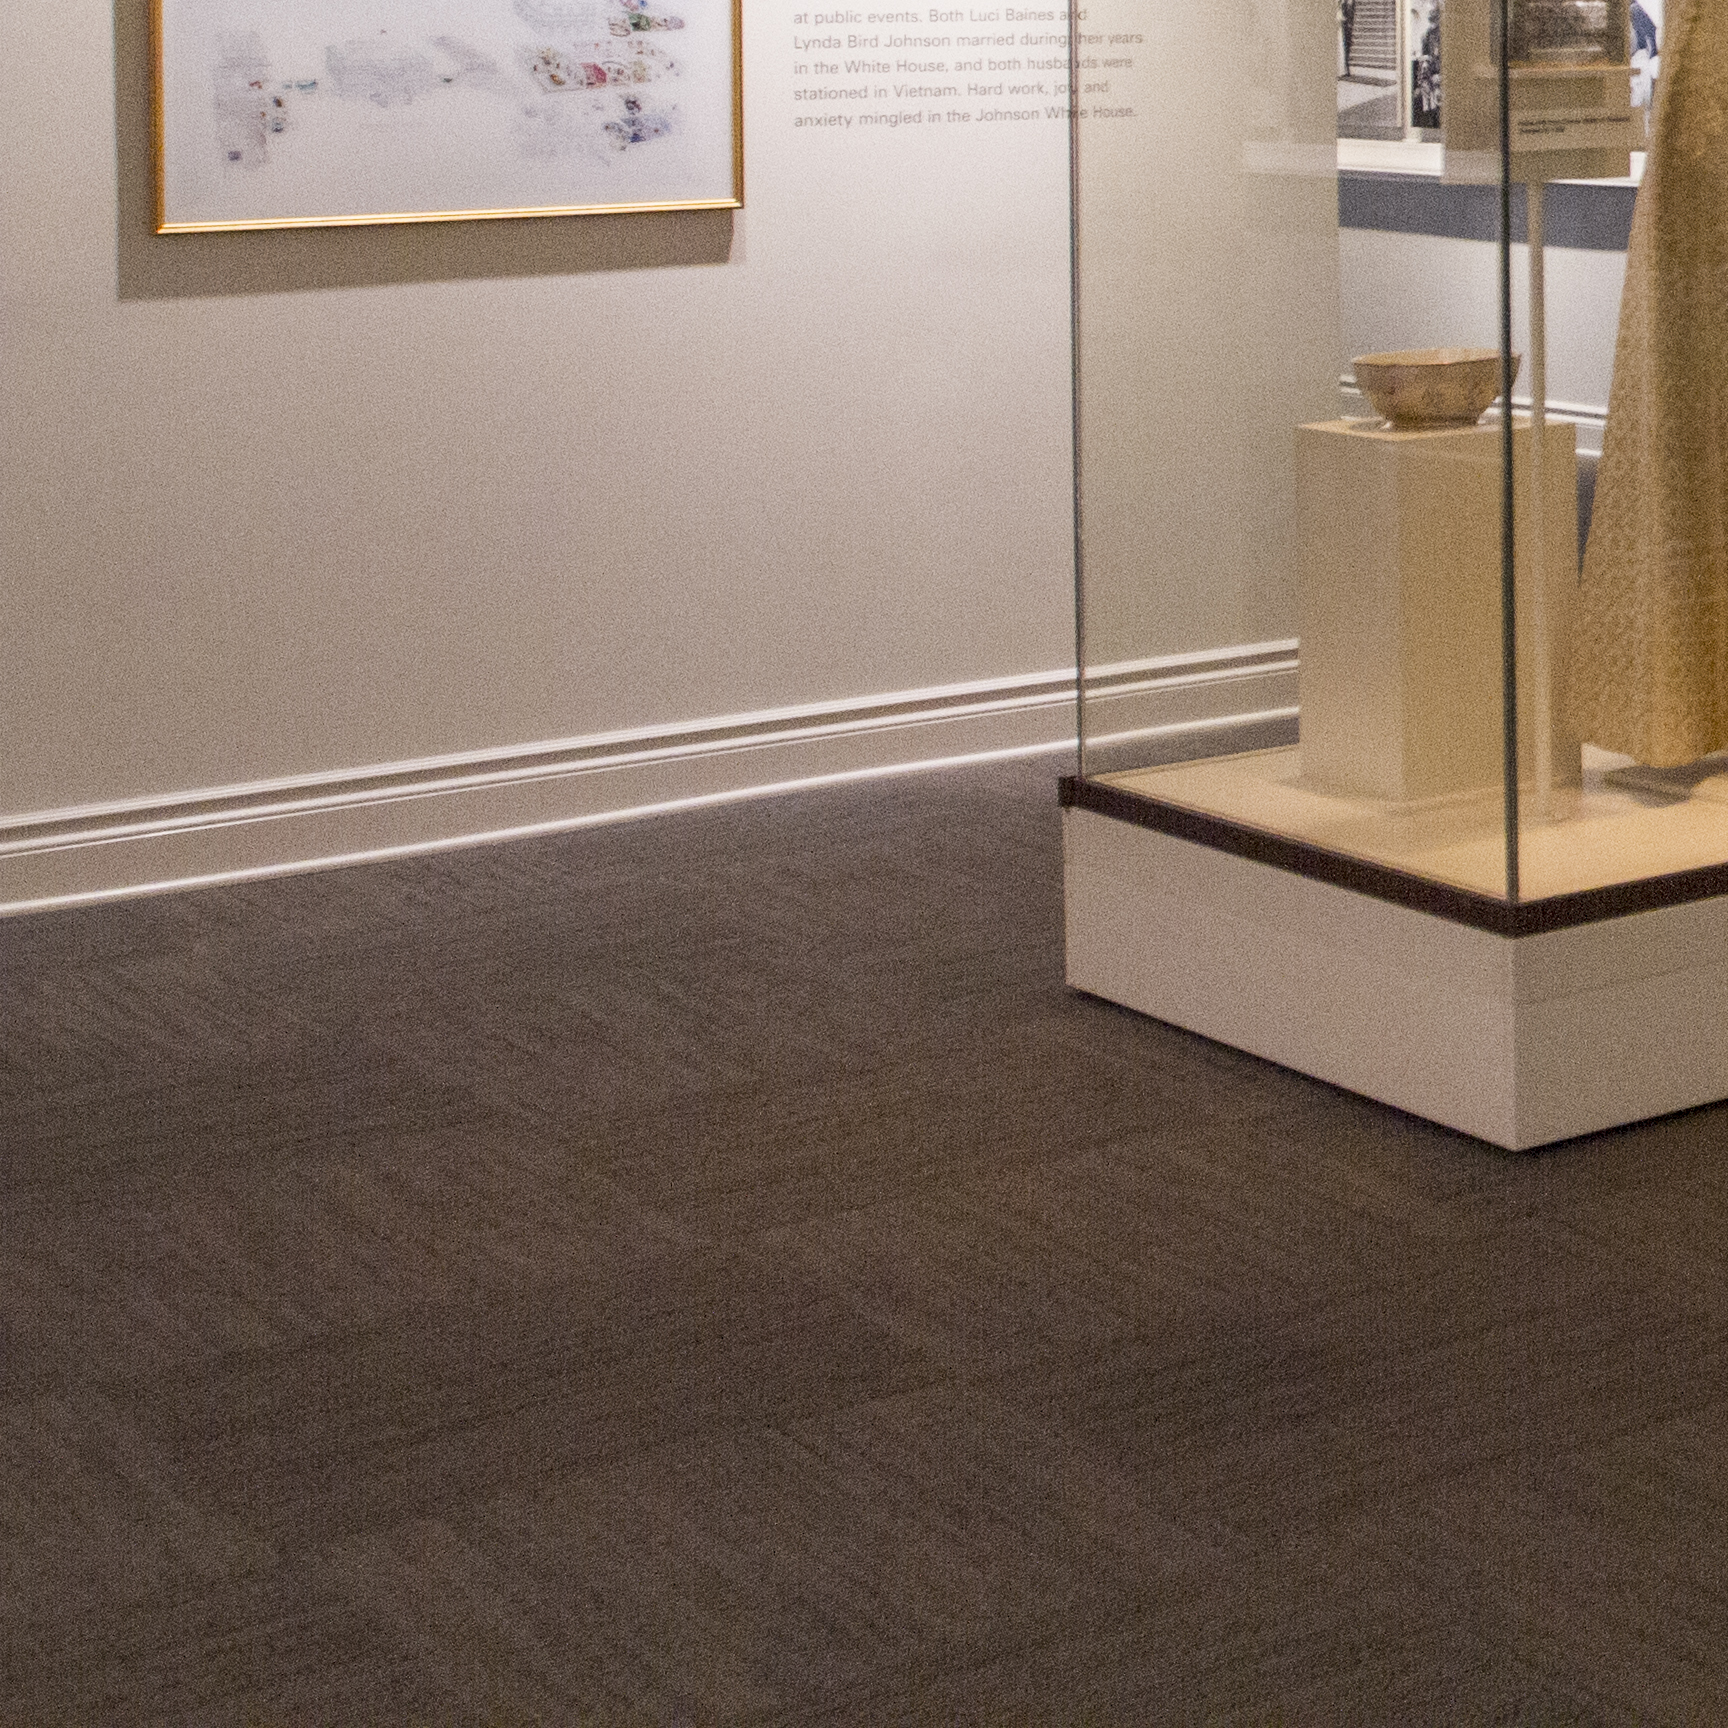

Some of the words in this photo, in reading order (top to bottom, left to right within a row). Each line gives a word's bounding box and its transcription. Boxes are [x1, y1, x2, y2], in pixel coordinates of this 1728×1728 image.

[794, 12, 808, 24] at
[814, 10, 862, 26] public
[867, 11, 923, 23] events.
[929, 9, 964, 23] Both
[969, 8, 1000, 22] Luci
[1005, 8, 1054, 21] Baines
[1059, 9, 1087, 21] ad
[794, 35, 841, 52] Lynda
[847, 34, 879, 48] Bird
[884, 35, 951, 48] Johnson
[956, 33, 1014, 46] married
[1020, 32, 1068, 48] during
[1073, 33, 1104, 44] heir
[1108, 34, 1144, 46] years
[794, 62, 808, 74] in
[814, 60, 839, 74] the
[845, 60, 891, 73] White
[896, 60, 949, 73] House,
[954, 59, 983, 71] and
[988, 58, 1021, 71] both
[1102, 58, 1133, 68] were
[794, 86, 868, 101] stationed
[874, 86, 888, 98] in
[893, 84, 962, 98] Vietnam.
[967, 83, 1003, 95] Hard
[1008, 81, 1049, 95] work,
[1084, 81, 1110, 93] and
[794, 113, 853, 129] anxiety
[858, 111, 923, 128] mingled
[927, 110, 941, 123] in
[946, 110, 970, 122] the
[975, 109, 1039, 123] Johnson
[1044, 106, 1088, 119] Whe
